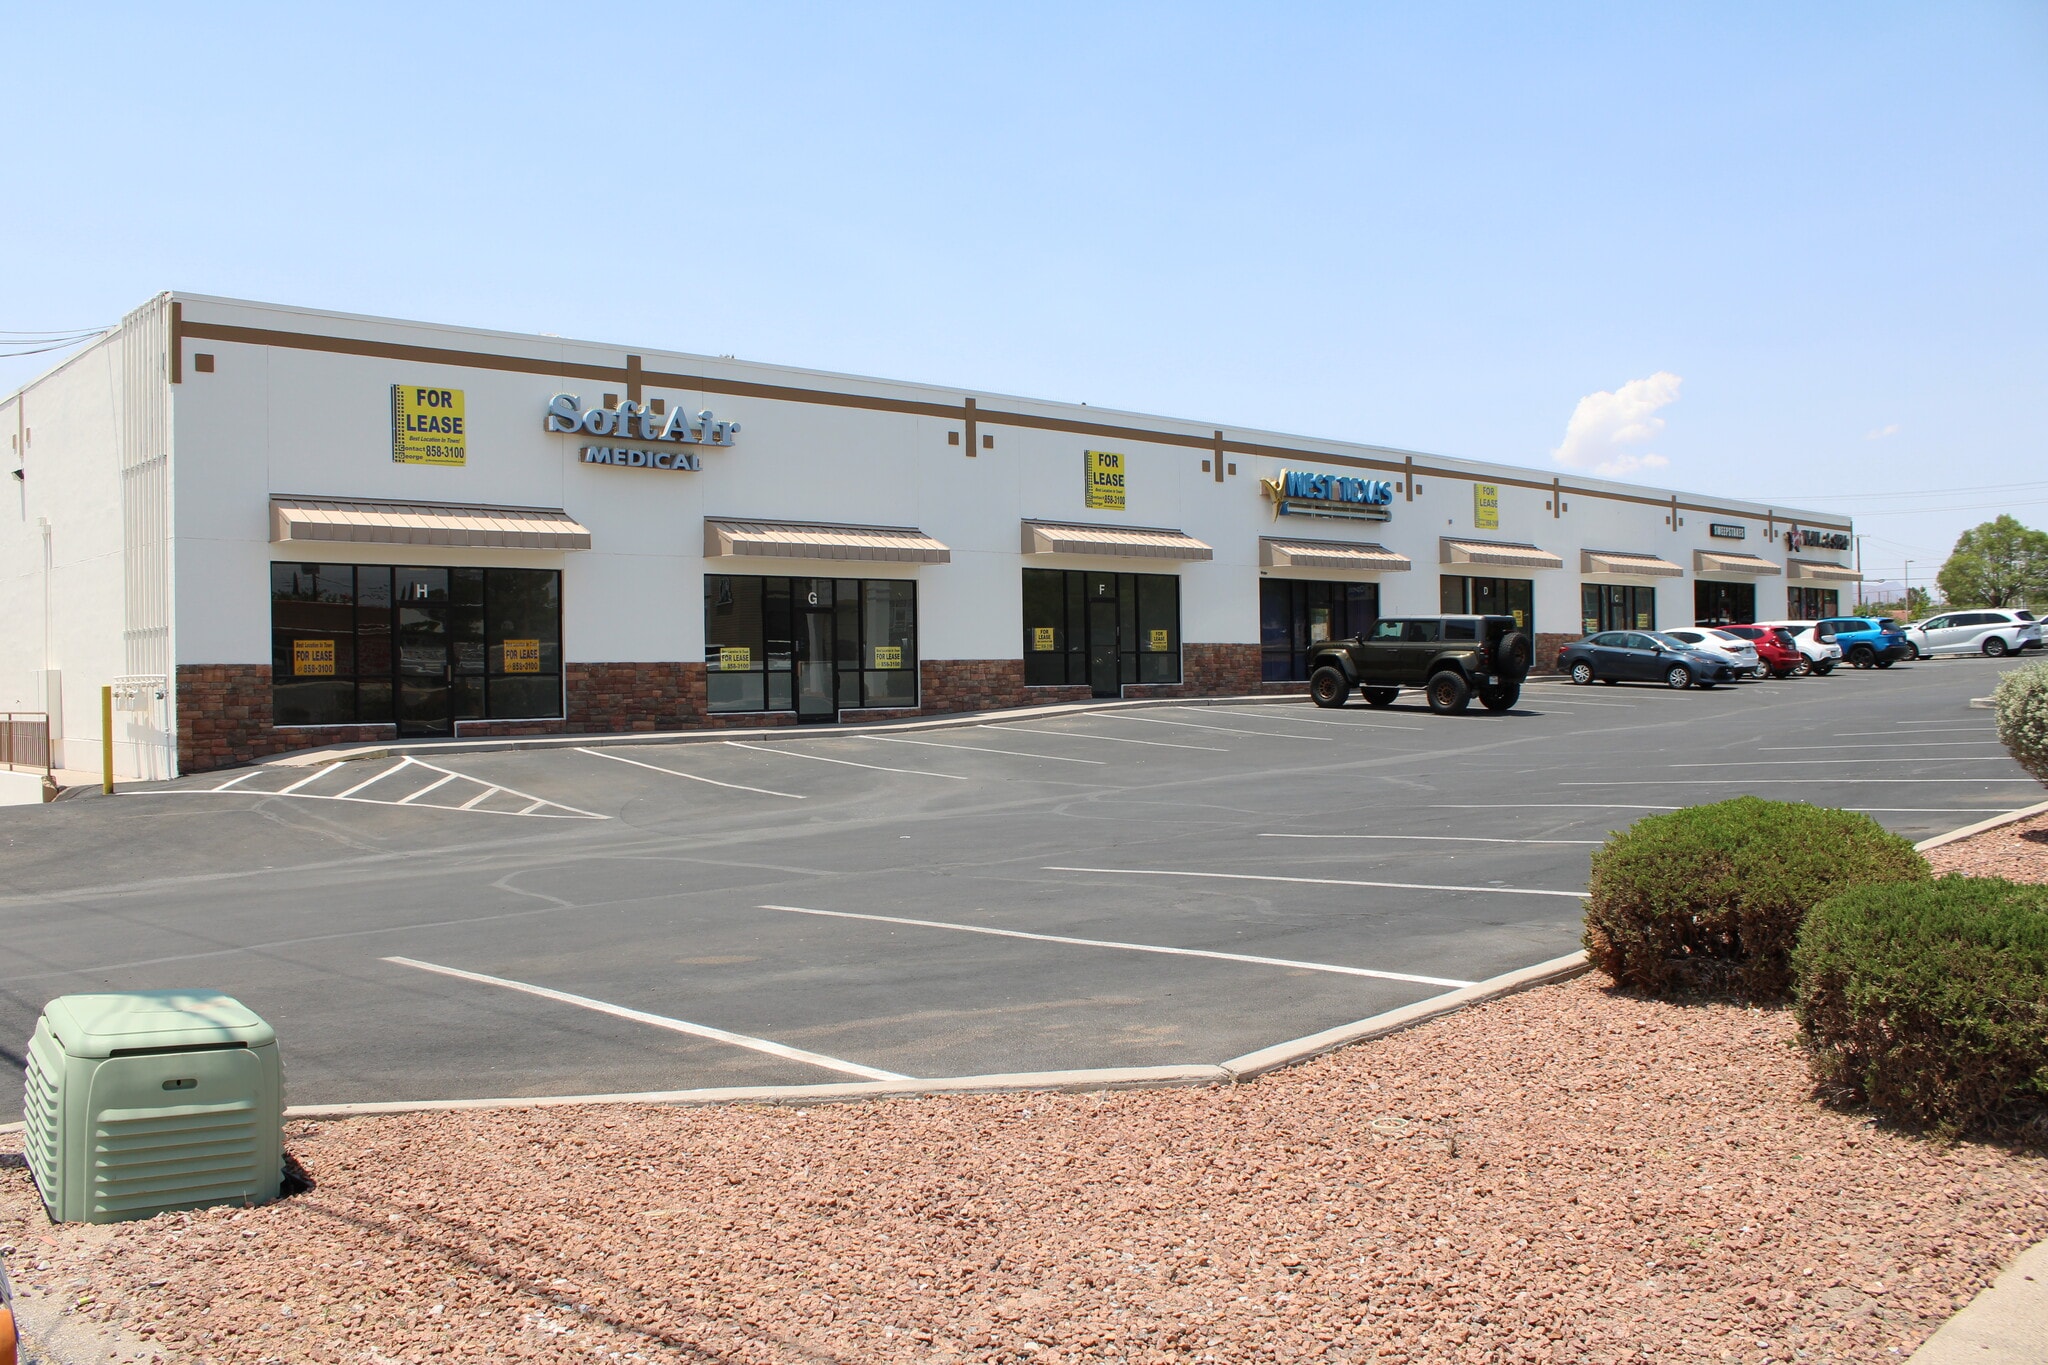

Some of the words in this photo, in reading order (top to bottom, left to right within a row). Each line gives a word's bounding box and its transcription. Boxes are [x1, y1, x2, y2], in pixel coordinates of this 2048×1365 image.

[417, 389, 453, 409] FOR
[406, 414, 463, 434] LEASE
[547, 392, 741, 446] SoftAir
[426, 445, 464, 459] 858-3100
[583, 446, 703, 471] MEDICAL
[1098, 453, 1119, 468] FOR
[1093, 471, 1125, 488] LEASE
[1285, 470, 1336, 500] WEST
[1336, 476, 1393, 505] TEXAS
[1482, 486, 1495, 496] FOR
[1479, 498, 1498, 508] LEASE
[416, 583, 428, 598] H
[1099, 584, 1106, 595] F
[1483, 586, 1489, 596] D
[808, 591, 818, 605] G
[1614, 594, 1619, 603] C
[296, 650, 310, 662] FOR
[312, 650, 332, 662] LEASE
[506, 649, 518, 659] FOR
[520, 649, 538, 659] LEASE
[722, 654, 732, 662] FOR
[733, 654, 749, 662] LEASE
[877, 653, 885, 661] FOR
[304, 664, 333, 673] 858-3100
